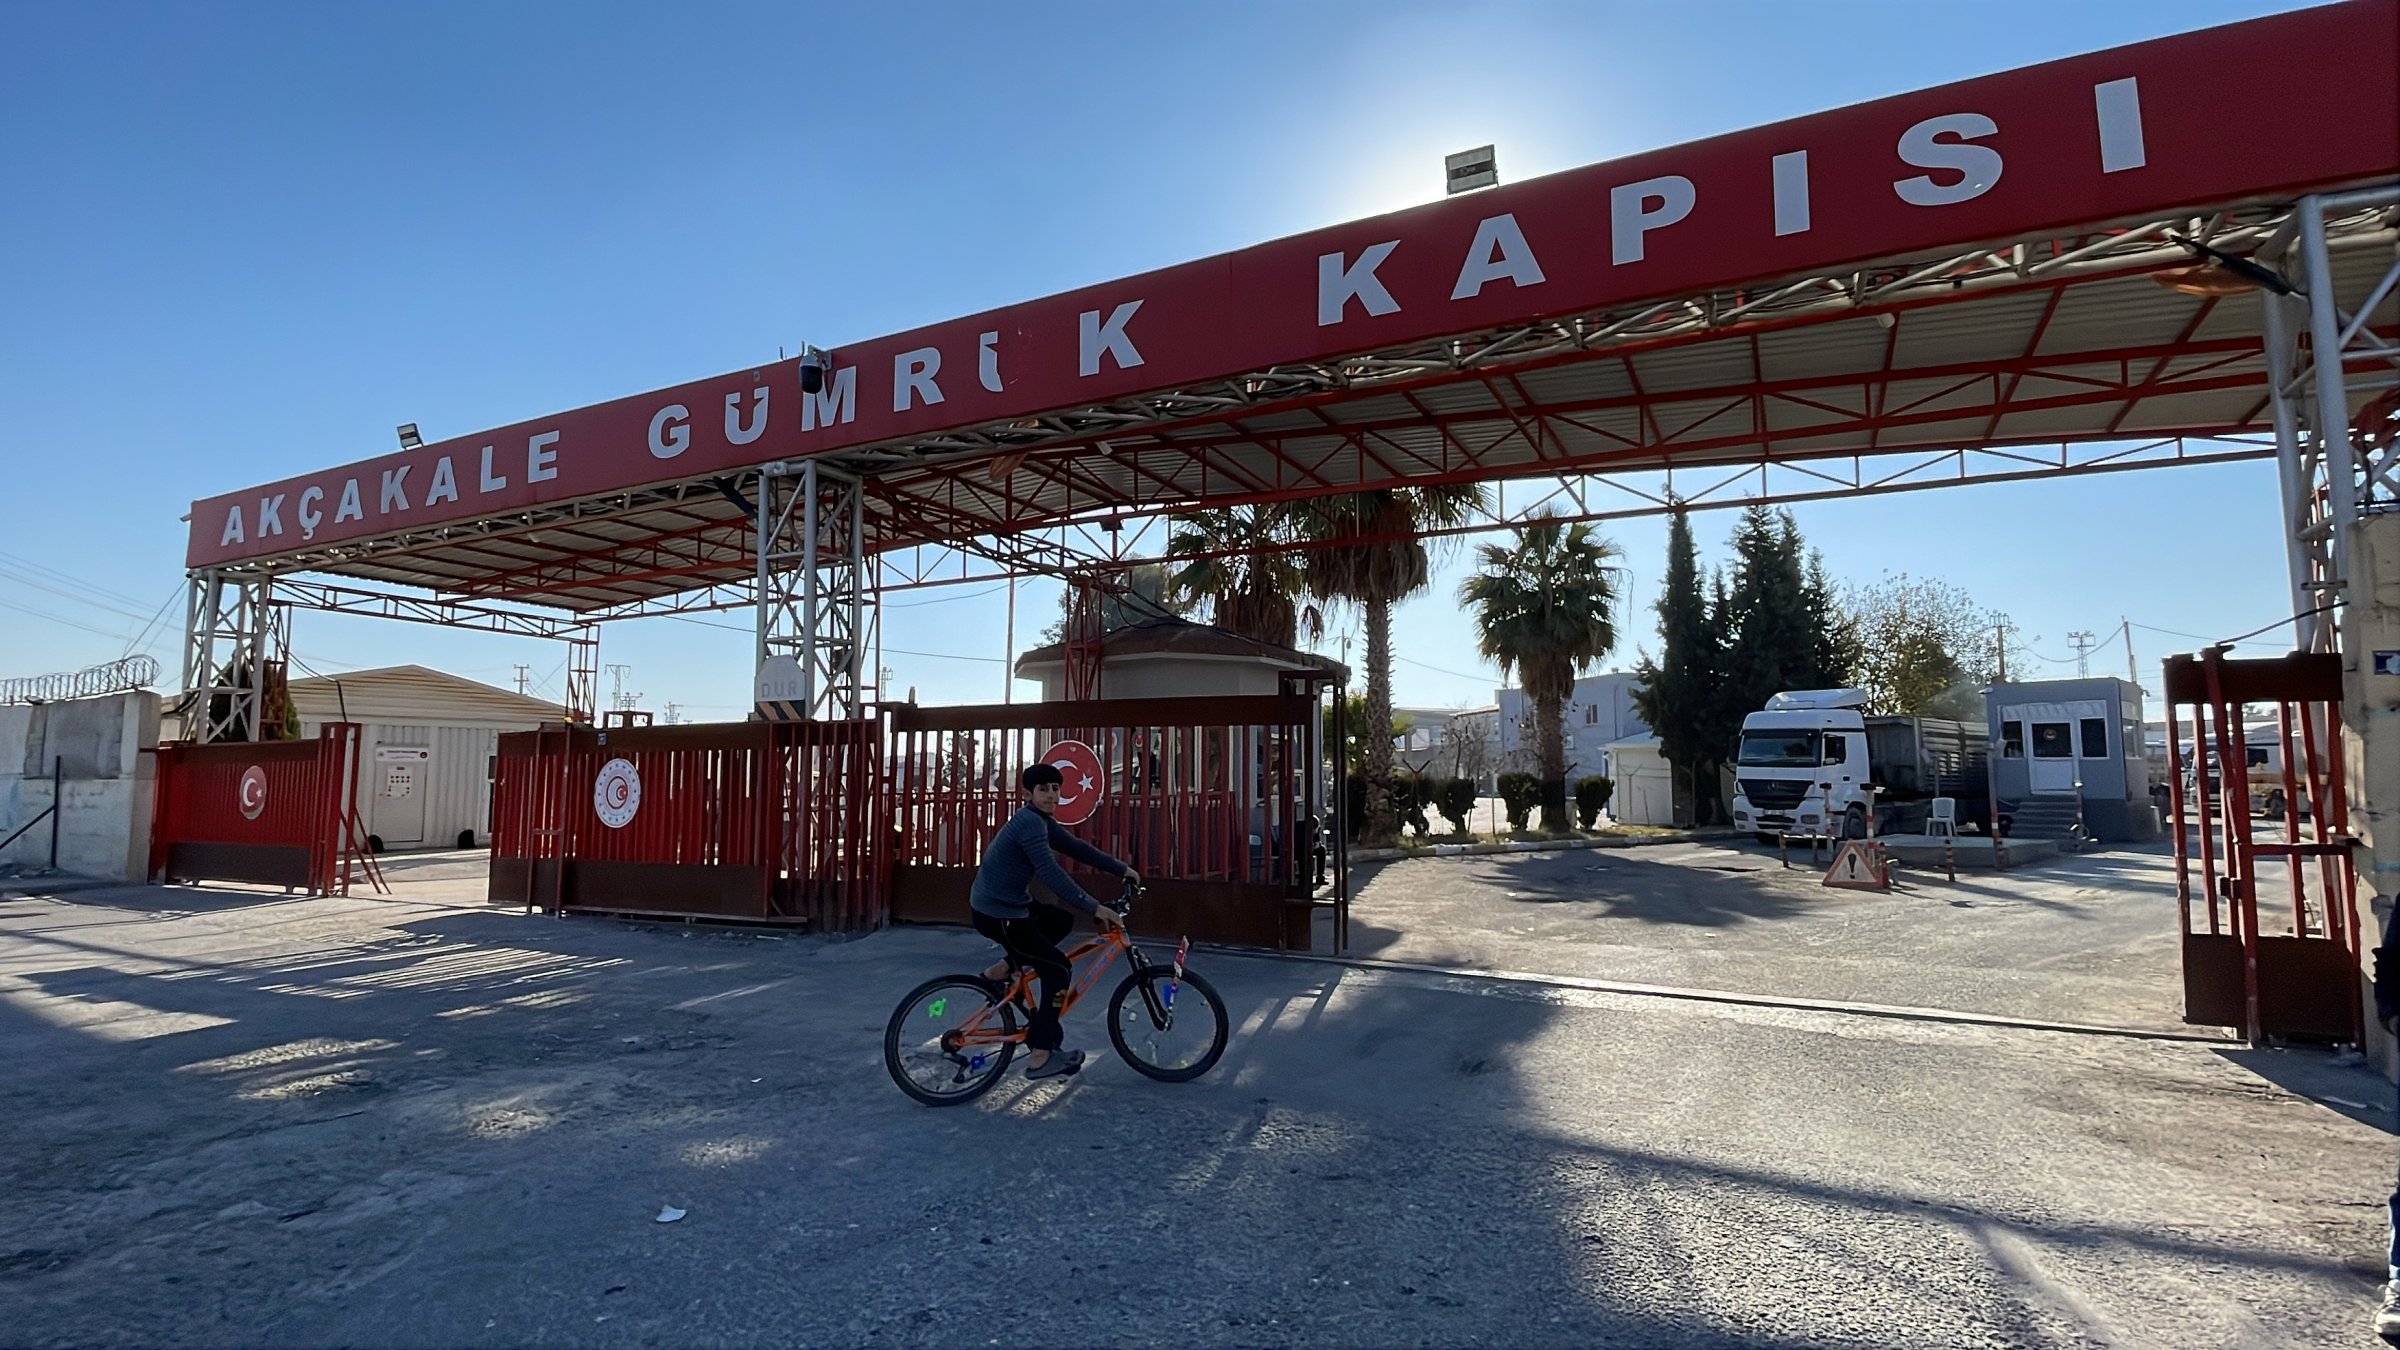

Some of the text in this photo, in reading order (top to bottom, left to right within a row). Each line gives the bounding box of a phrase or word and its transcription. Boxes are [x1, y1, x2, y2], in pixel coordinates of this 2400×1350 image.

[220, 429, 561, 547] AKÇAKALE
[1318, 76, 2147, 327] KAPISI
[761, 681, 798, 698] DUR
